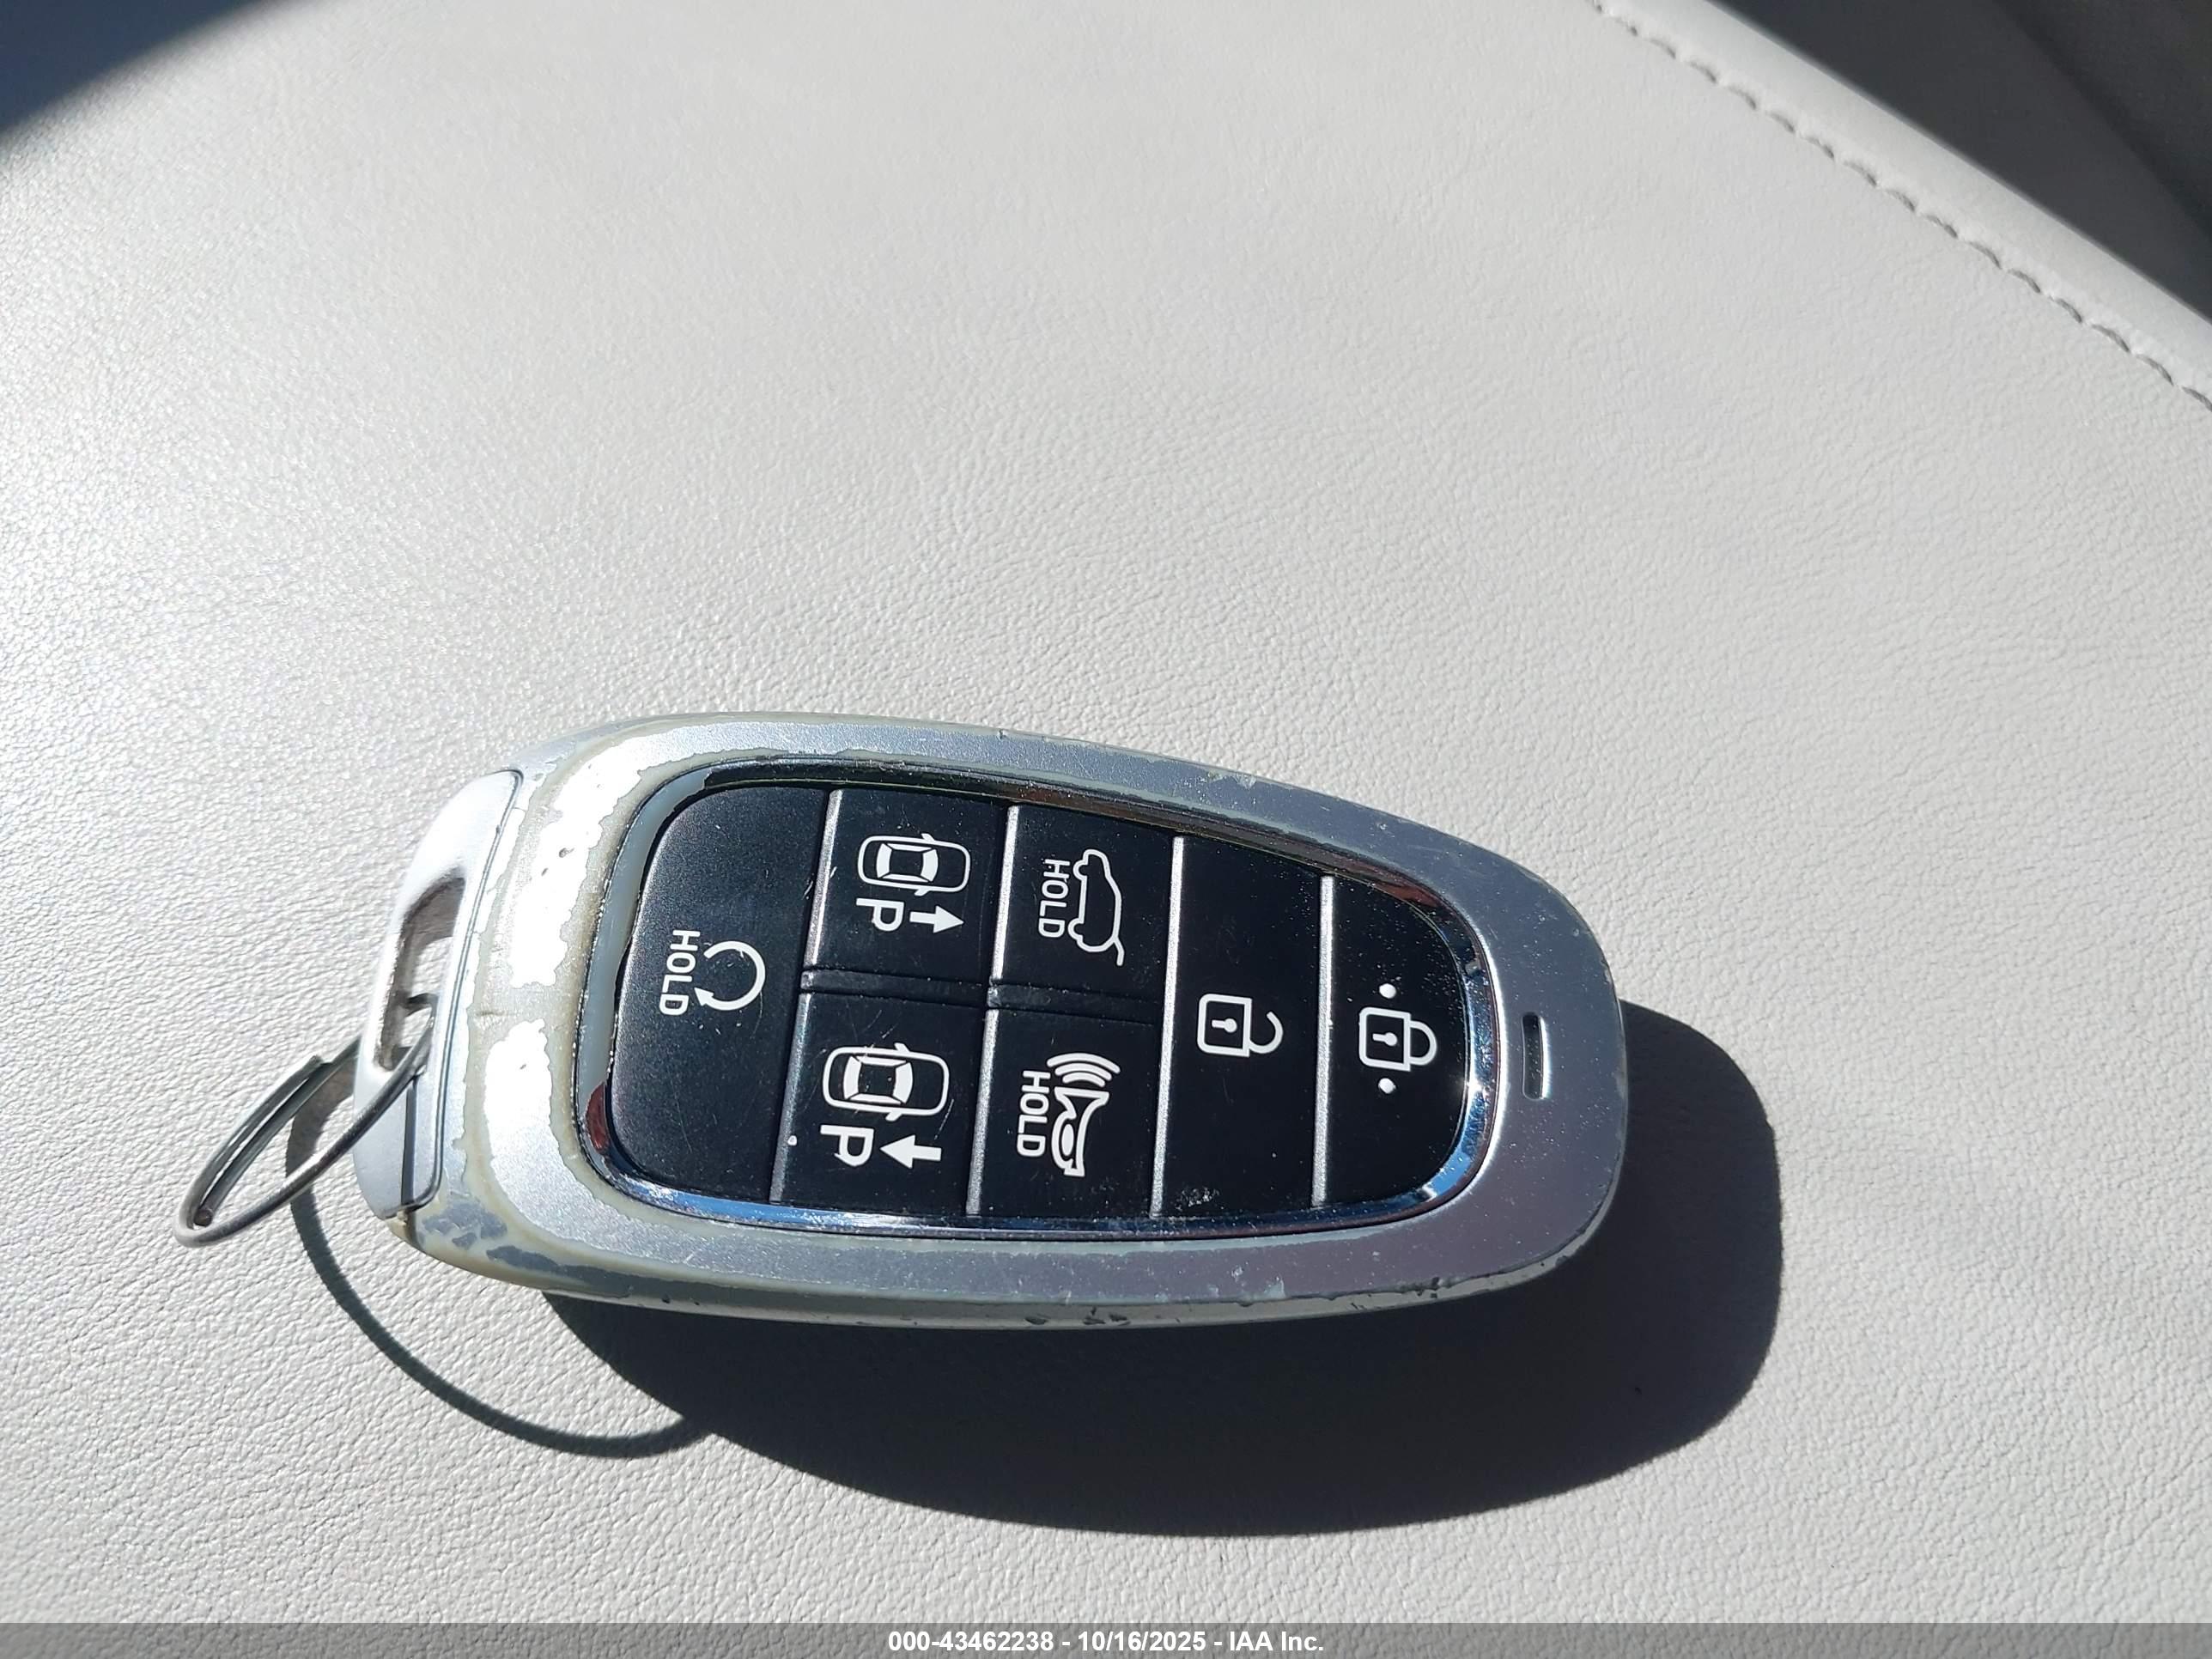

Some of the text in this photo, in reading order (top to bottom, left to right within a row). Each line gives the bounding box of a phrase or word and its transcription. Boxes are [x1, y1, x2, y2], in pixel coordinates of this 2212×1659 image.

[855, 897, 905, 932] P
[1038, 859, 1071, 938] HOLD
[659, 929, 701, 1016] HOLD
[819, 1124, 874, 1167] P
[1017, 1070, 1051, 1157] HOLD
